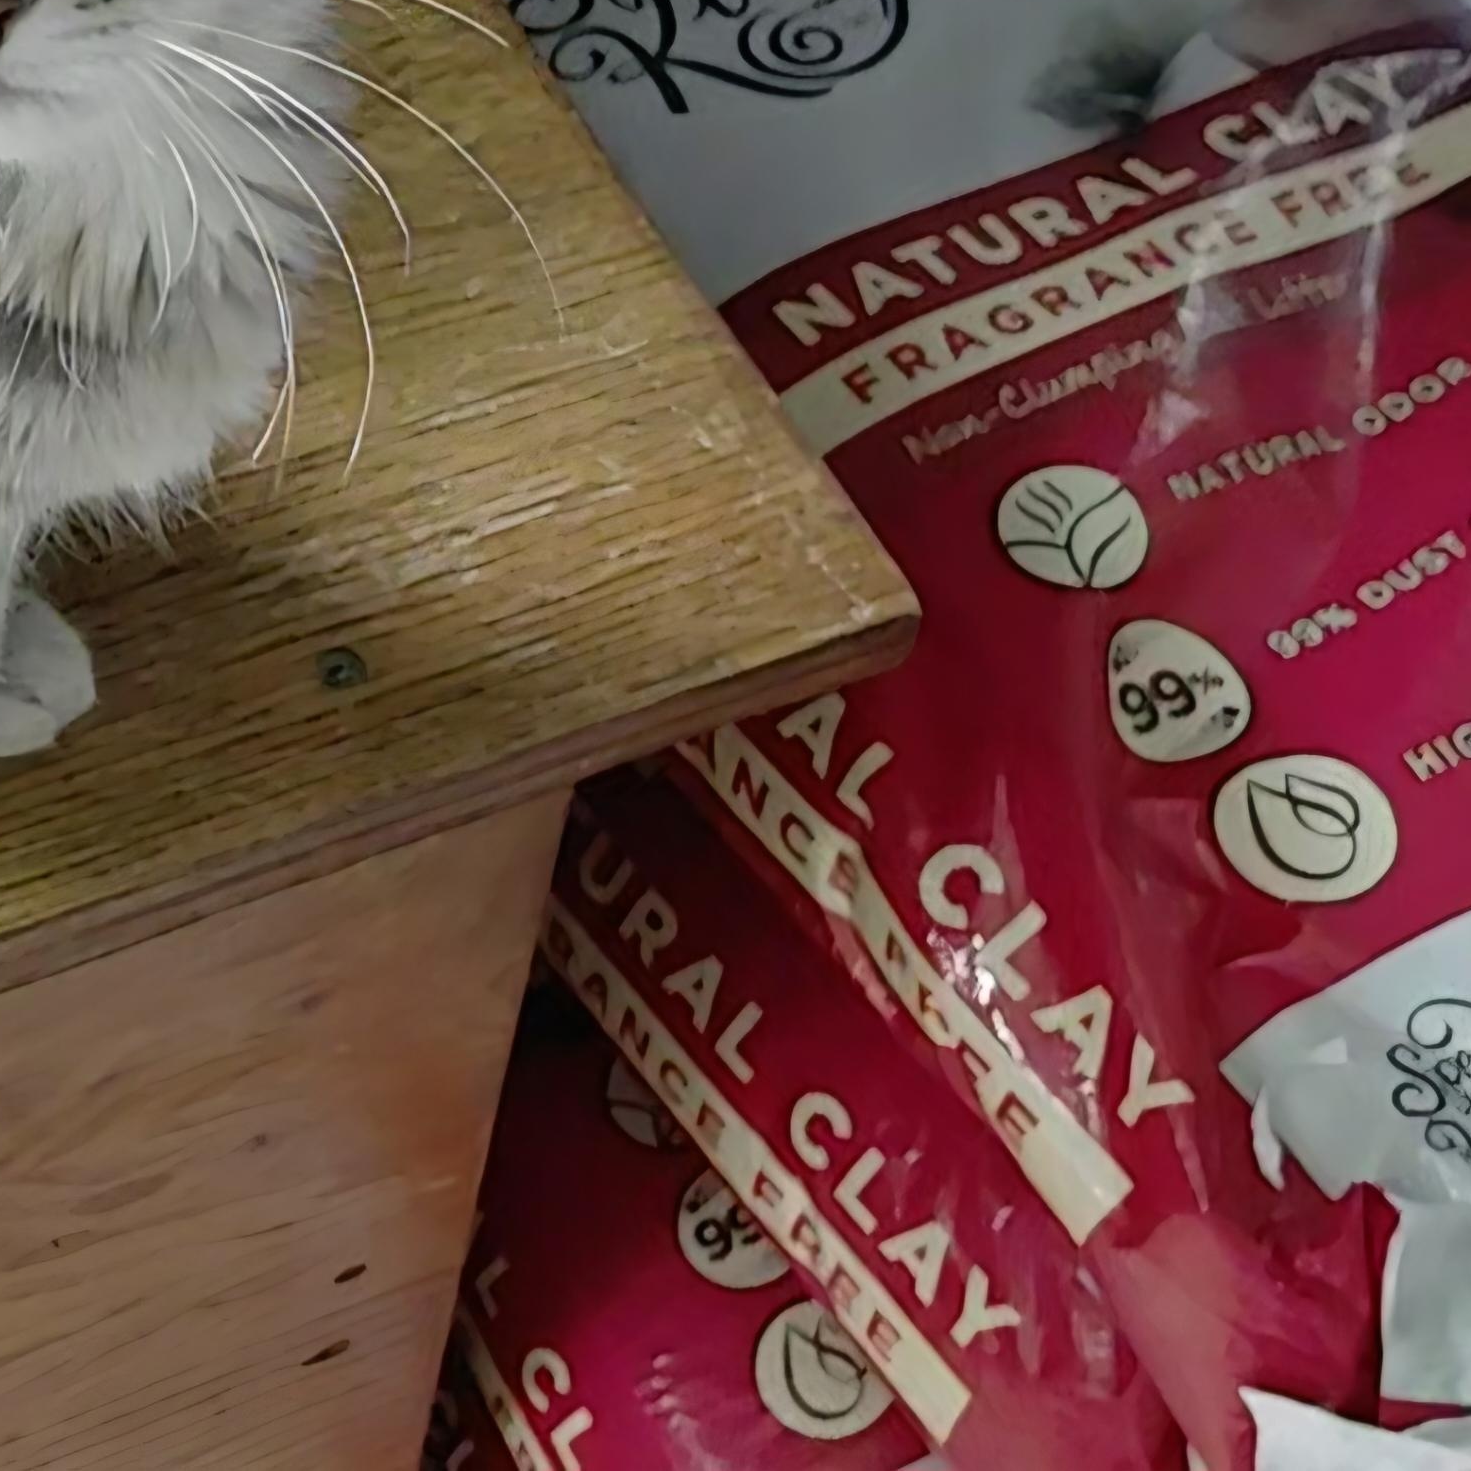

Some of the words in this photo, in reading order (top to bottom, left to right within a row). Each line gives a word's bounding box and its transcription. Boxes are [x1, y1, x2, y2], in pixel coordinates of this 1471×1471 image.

[771, 157, 1199, 348] NATURAL
[1203, 60, 1410, 163] CLAY
[840, 209, 1259, 405] FRAGRANCE
[1166, 425, 1347, 502] NATURAL
[1351, 356, 1471, 437] ODOR
[1355, 529, 1467, 611] DUST
[918, 843, 1196, 1130] CLAY
[789, 1091, 1021, 1346] CLAY
